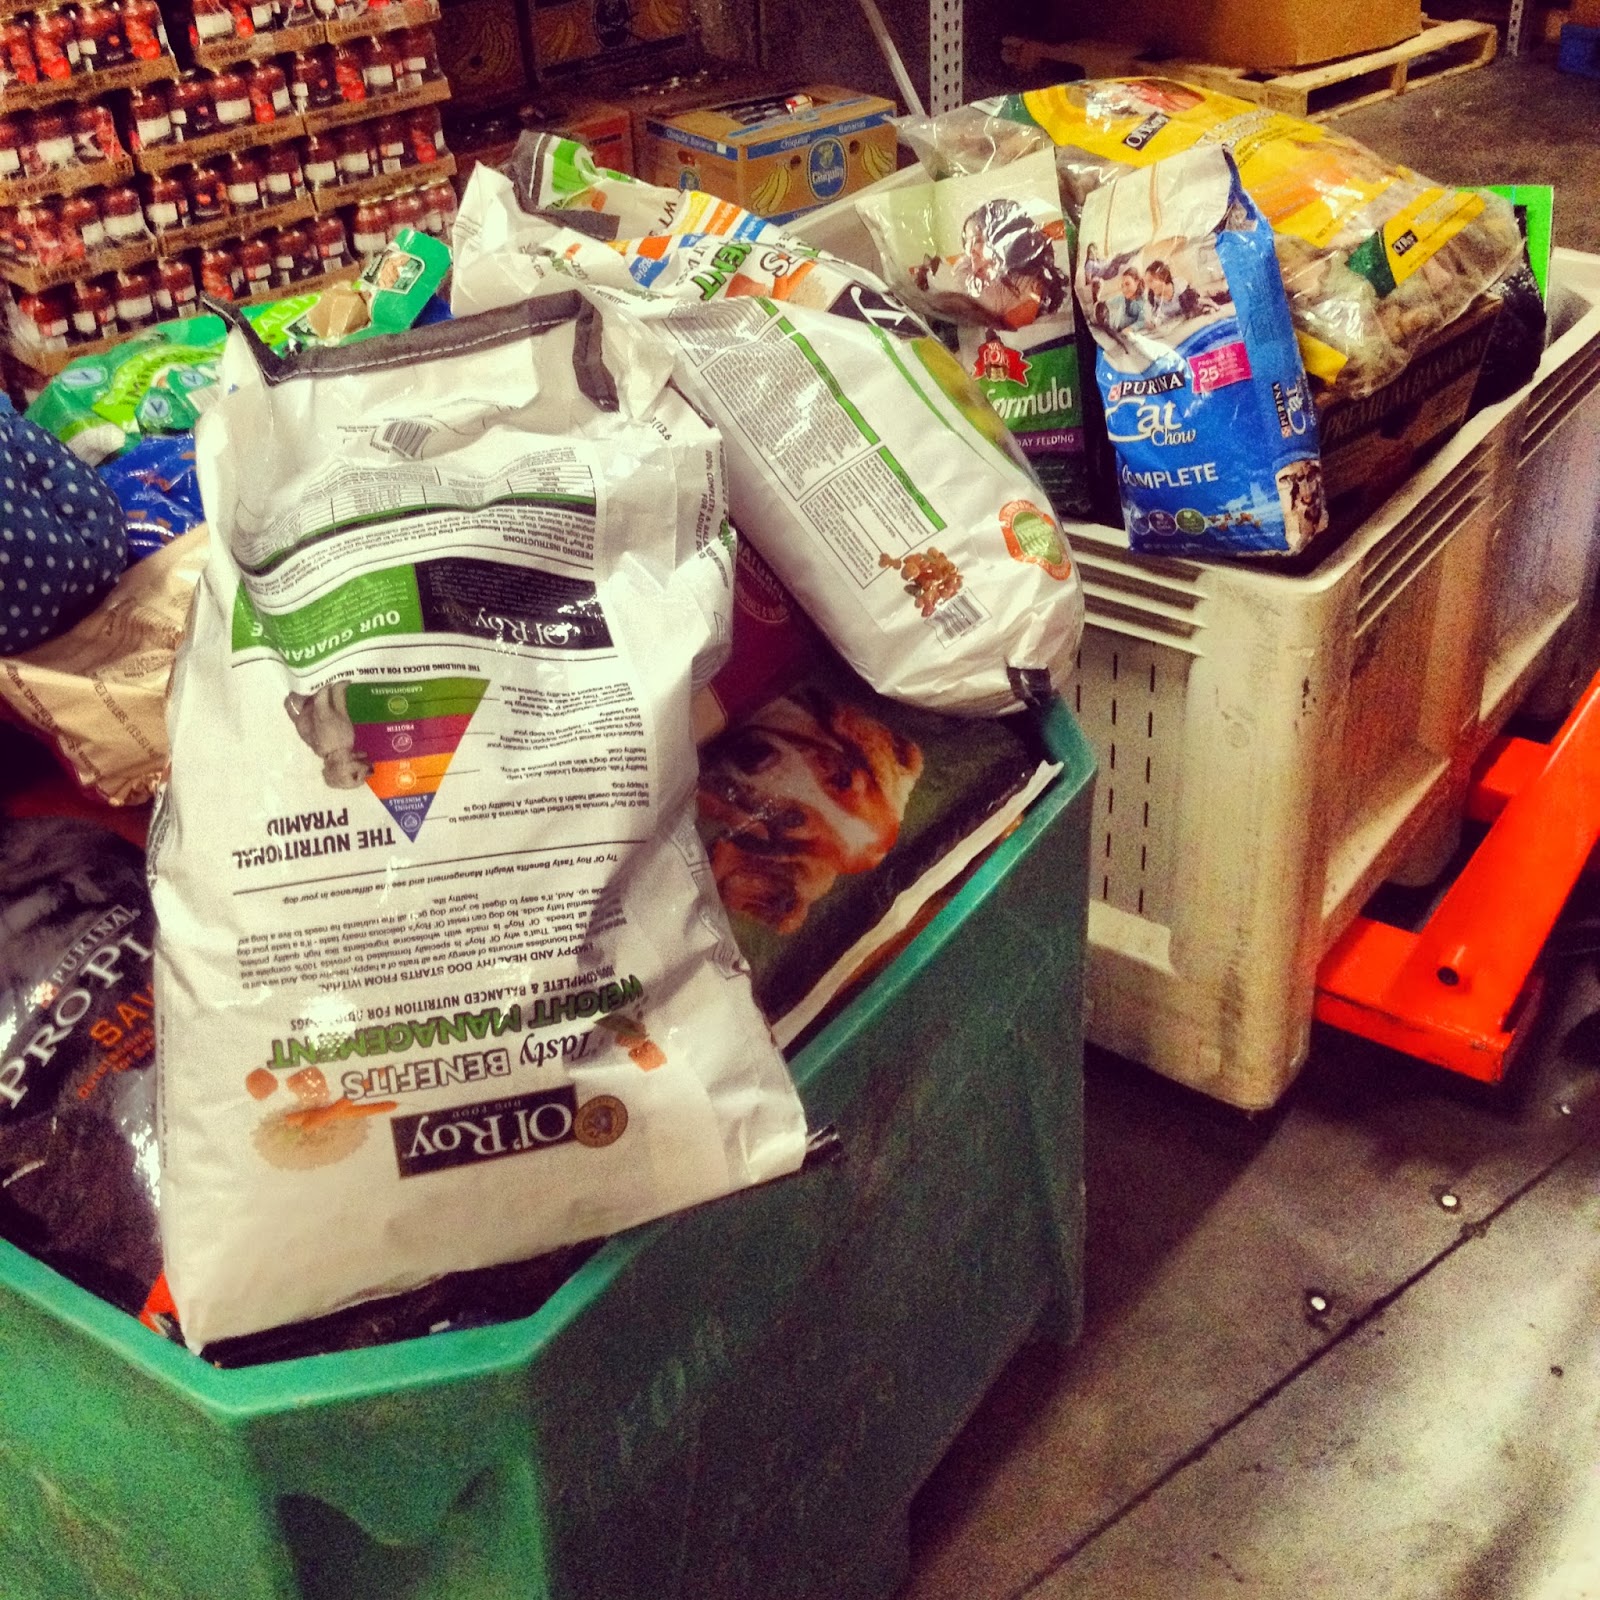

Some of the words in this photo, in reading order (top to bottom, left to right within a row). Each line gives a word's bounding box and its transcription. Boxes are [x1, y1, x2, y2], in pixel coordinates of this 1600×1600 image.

[1122, 373, 1183, 396] PURINA
[1105, 397, 1182, 443] Cat
[1036, 435, 1074, 445] FEEDING
[1151, 428, 1197, 447] Chow
[503, 534, 561, 552] INSTRUCTIONS
[562, 546, 594, 560] FEEDING
[360, 610, 400, 633] OUR
[266, 808, 349, 836] PYRAMID
[357, 828, 396, 849] THE
[531, 949, 554, 961] AND
[401, 967, 444, 980] STARTS
[448, 962, 473, 975] DOG
[364, 973, 398, 986] FROM
[531, 983, 540, 995] &
[543, 969, 597, 994] COMPLETE
[464, 985, 526, 1005] BALANCED
[528, 975, 643, 1028] WEIGHT
[367, 1004, 390, 1019] FOR
[395, 996, 460, 1016] NUTRITION
[0, 988, 92, 1109] PRO
[519, 1031, 592, 1068] Tasty
[341, 1048, 511, 1101] BENEFITS
